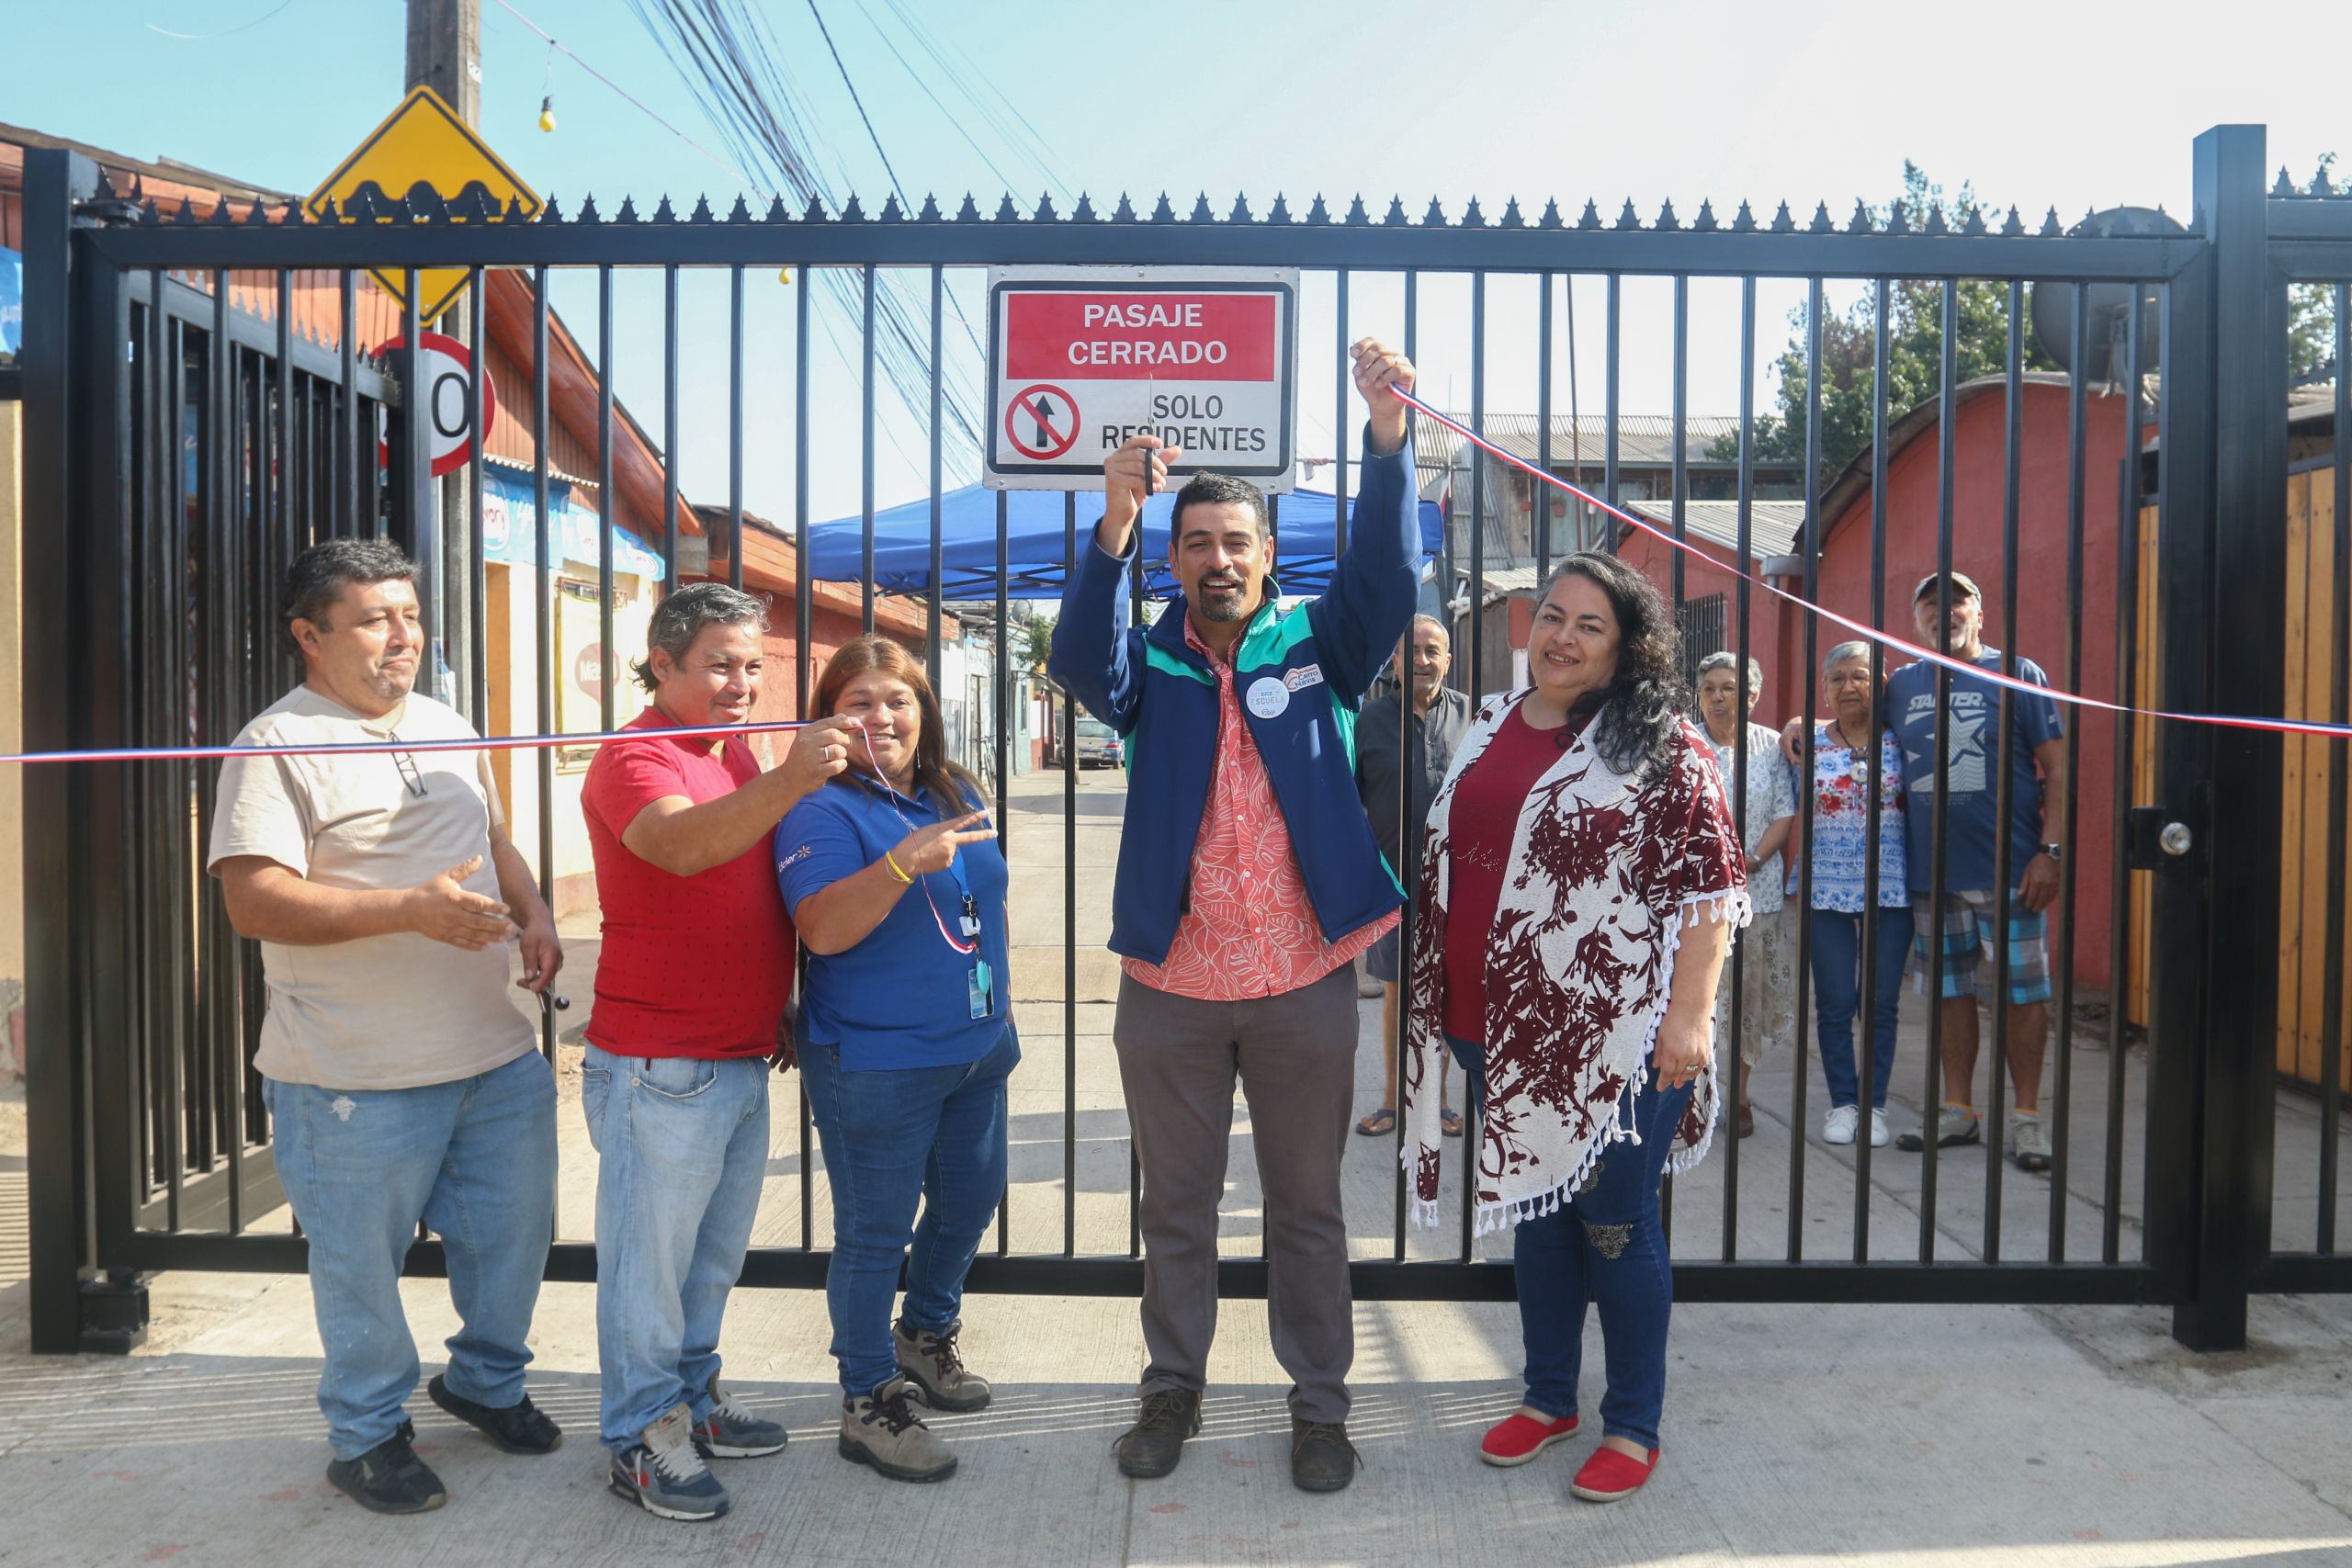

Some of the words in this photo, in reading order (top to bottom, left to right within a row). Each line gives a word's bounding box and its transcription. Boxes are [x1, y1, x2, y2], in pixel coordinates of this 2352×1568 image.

[1084, 304, 1204, 328] PASAJE
[1068, 341, 1227, 365] CERRADO
[1153, 395, 1223, 419] SOLO
[1295, 678, 1317, 689] Navia
[1297, 671, 1318, 681] Cerro
[1907, 692, 1984, 711] STATER
